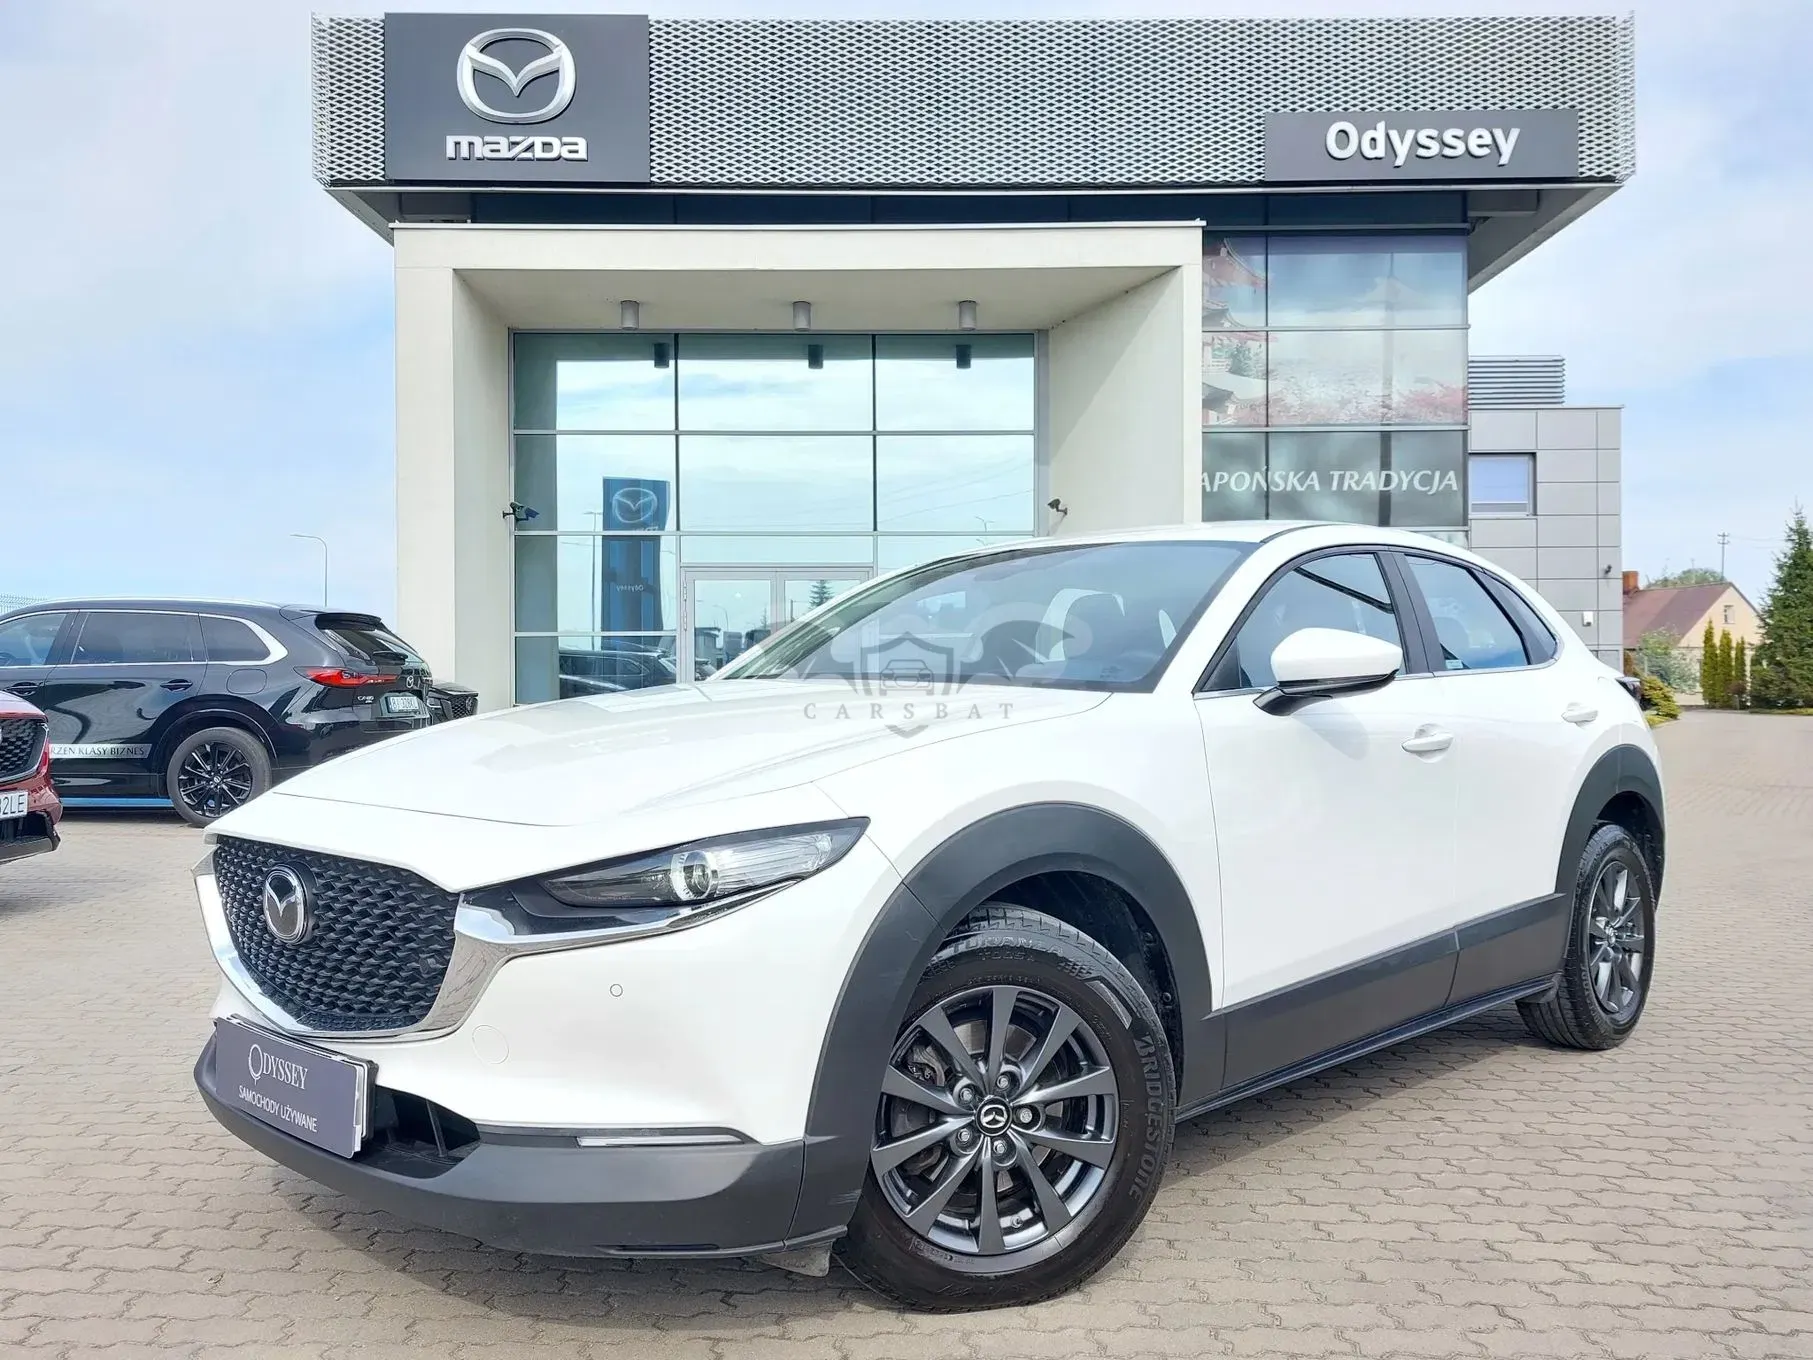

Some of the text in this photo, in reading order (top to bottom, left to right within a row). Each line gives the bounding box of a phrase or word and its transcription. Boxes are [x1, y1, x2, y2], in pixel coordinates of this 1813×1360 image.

[1325, 120, 1521, 168] Odyssey
[1329, 470, 1459, 495] TRADYCJA
[78, 747, 107, 755] KLASY
[110, 747, 144, 755] BIZNES
[0, 794, 25, 815] 2LE
[248, 1043, 309, 1090] ODYSSEY
[238, 1085, 318, 1133] SAMOCHODY UŻYWANE
[1128, 1035, 1164, 1201] BRIDGESTONE
